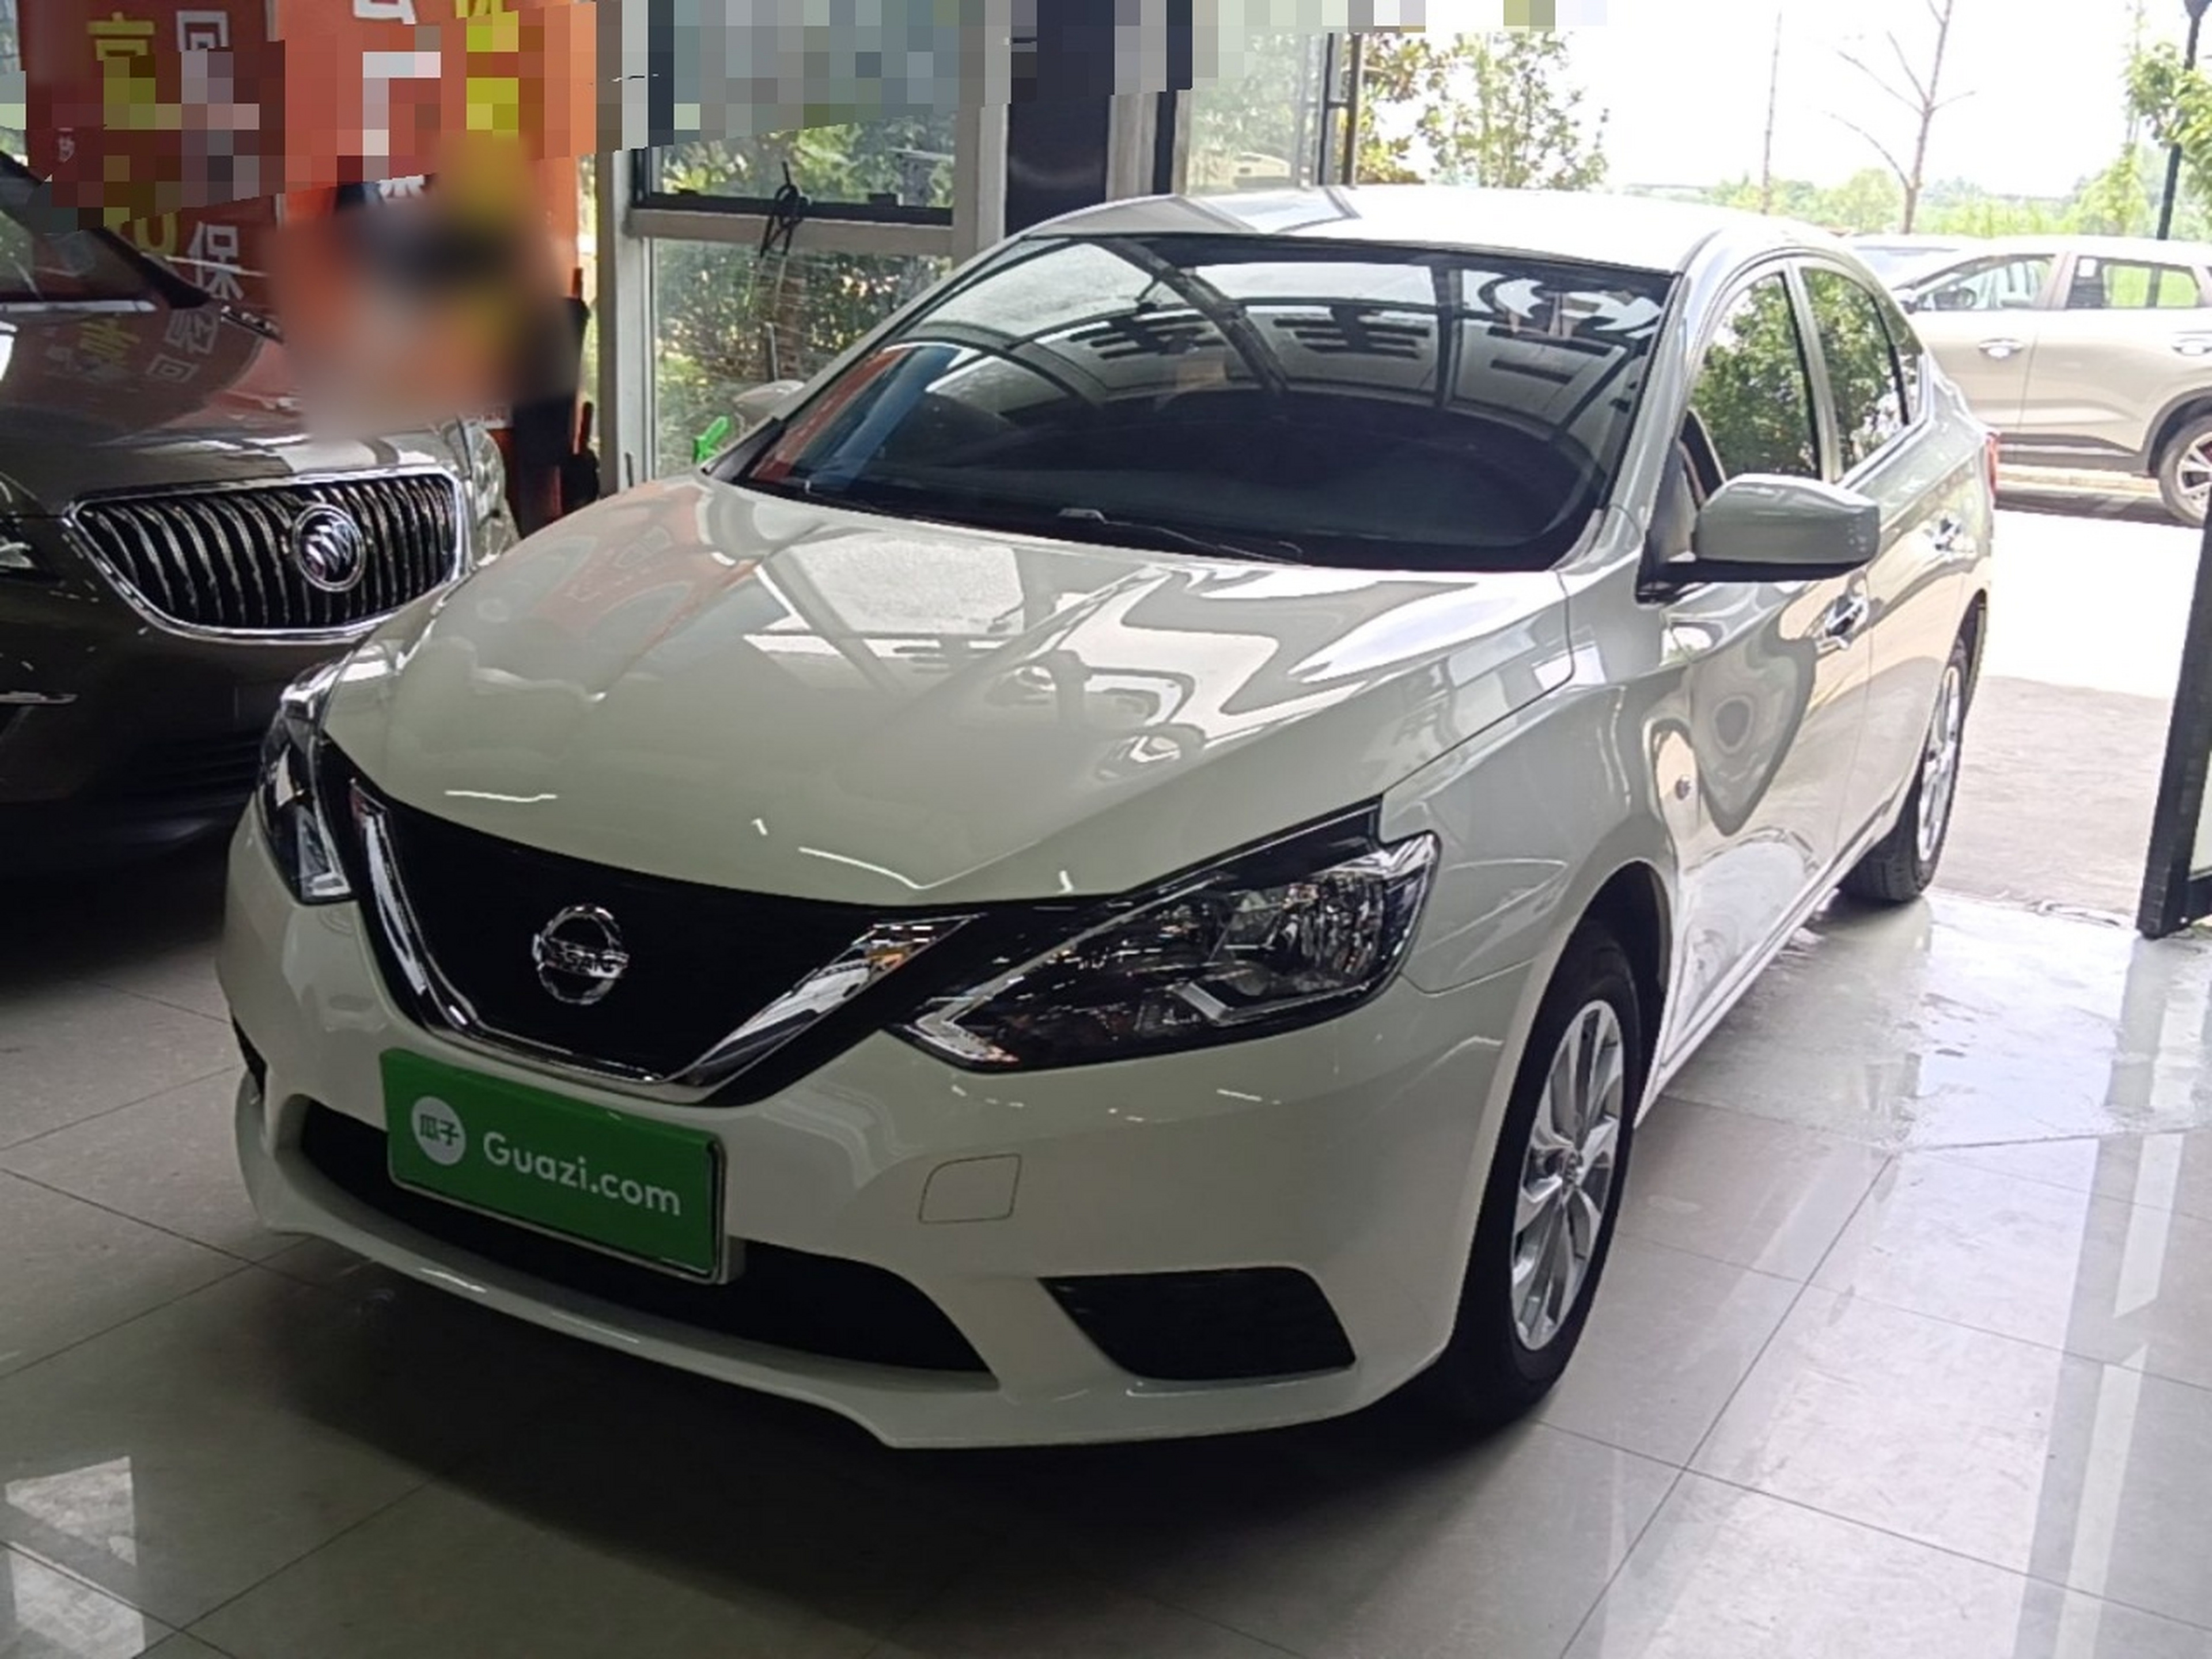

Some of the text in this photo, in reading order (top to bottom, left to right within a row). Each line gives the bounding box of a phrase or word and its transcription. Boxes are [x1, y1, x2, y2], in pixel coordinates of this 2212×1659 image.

[187, 221, 244, 300] 保
[420, 1113, 460, 1146] 瓜子
[483, 1131, 681, 1216] Guazi.com
